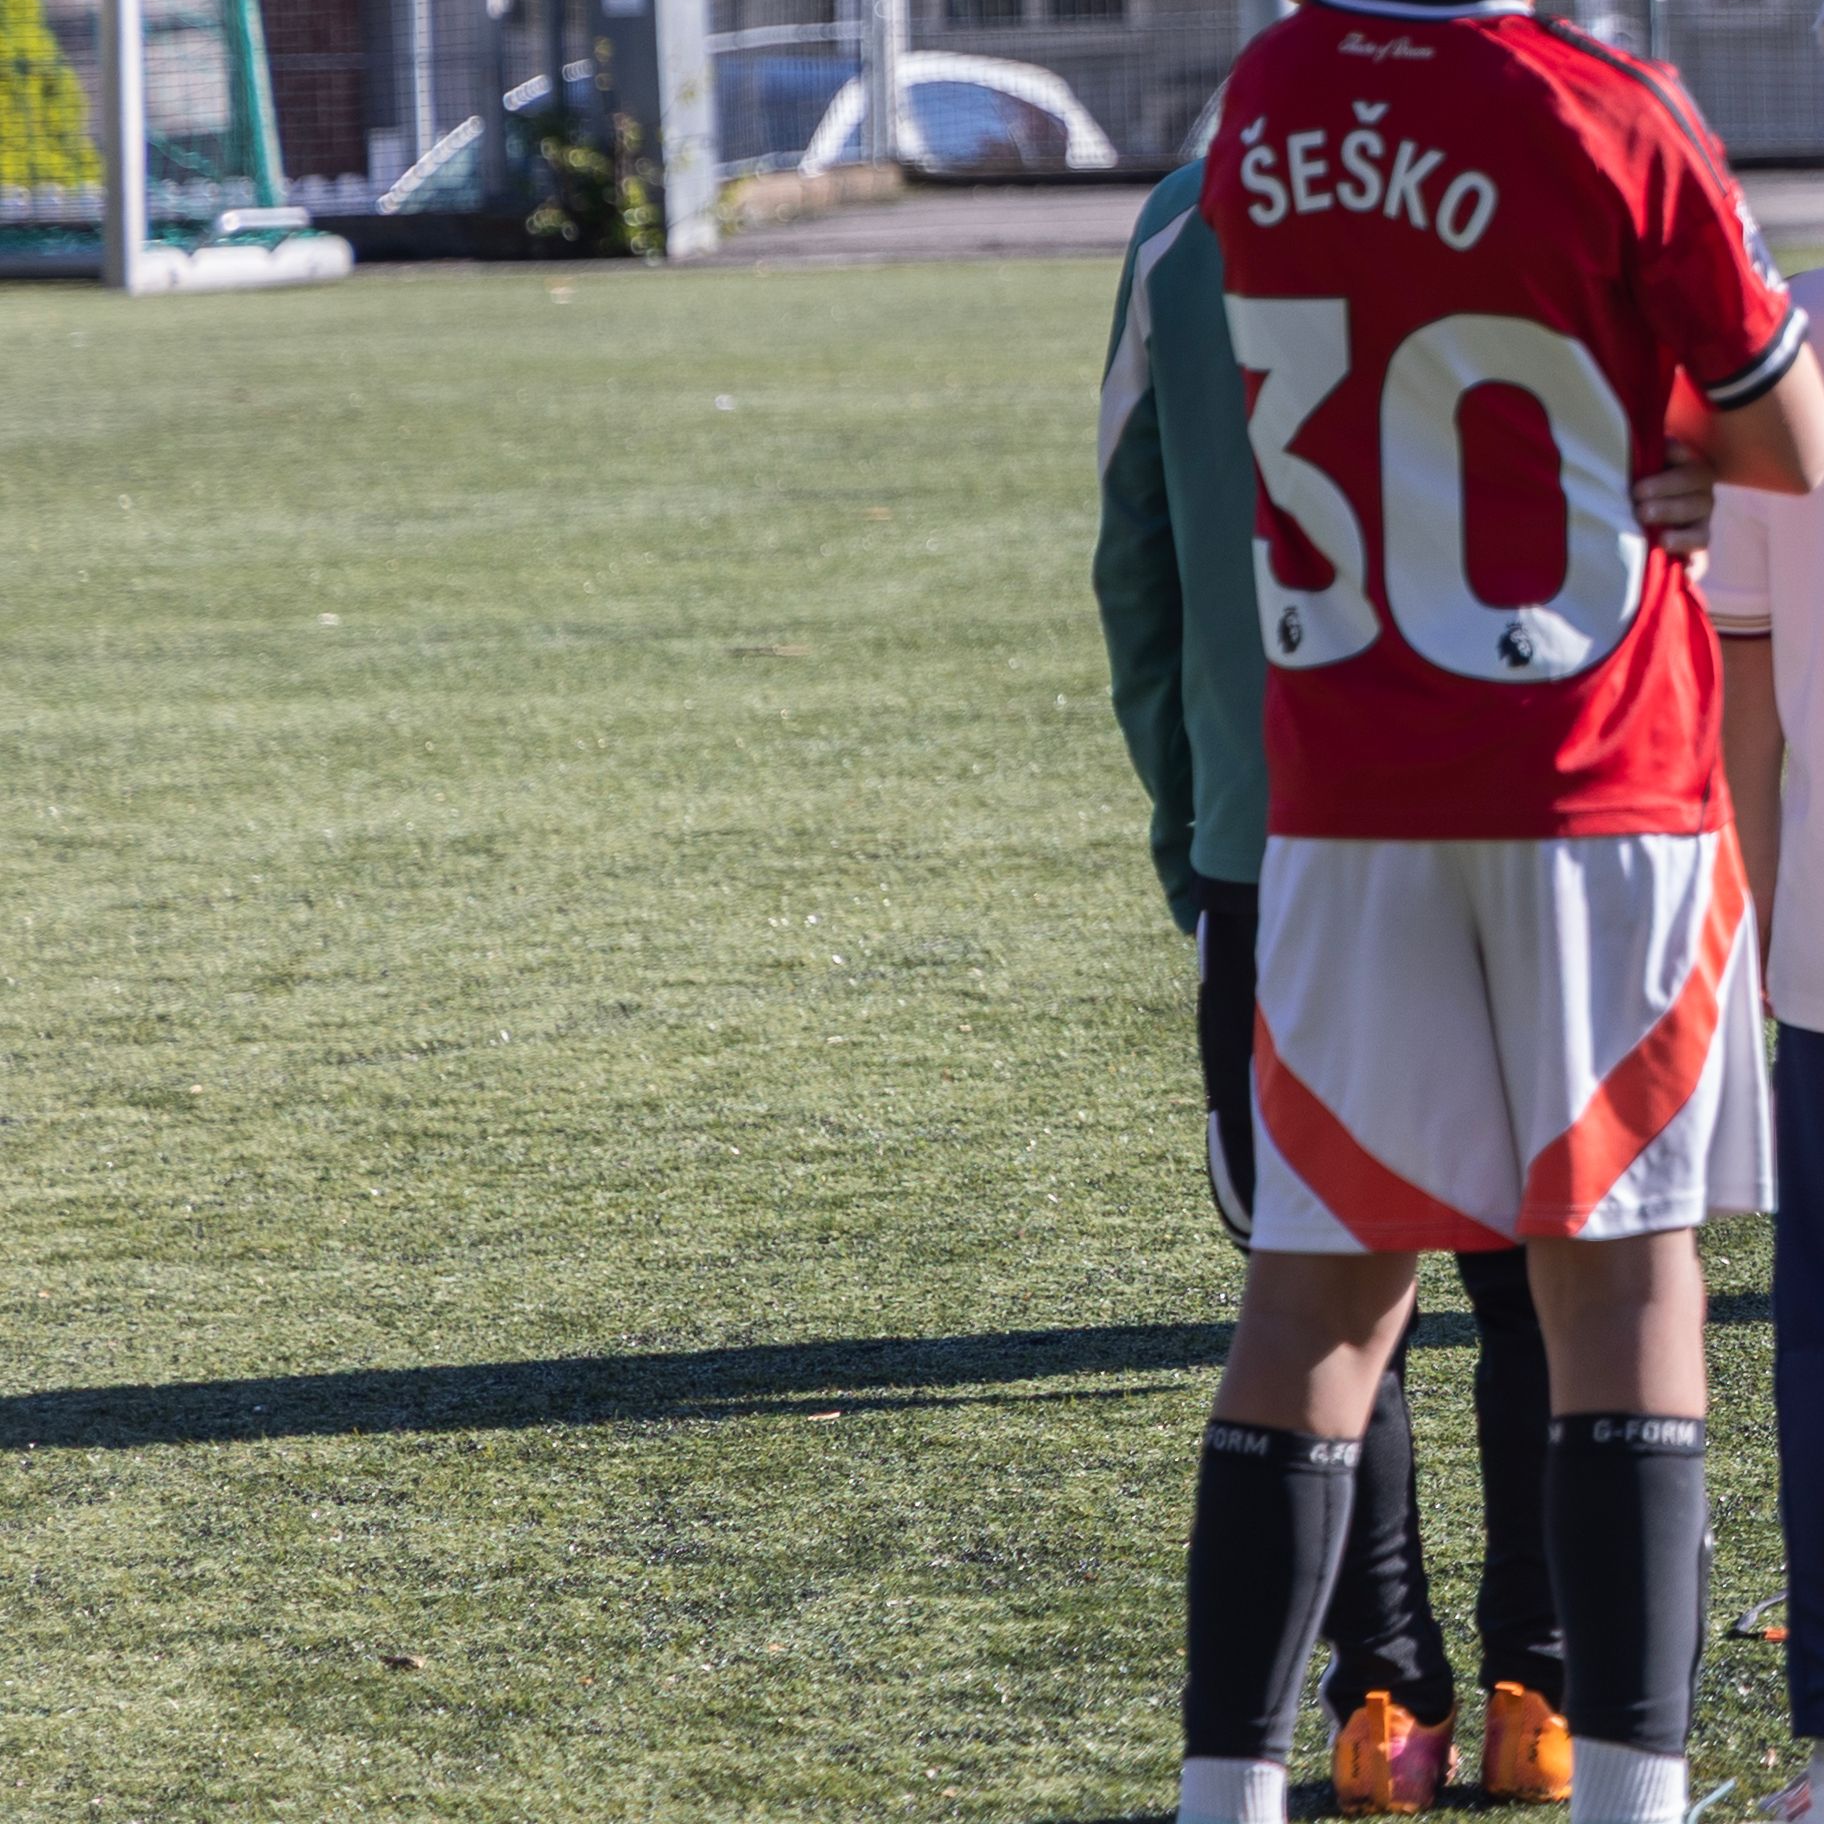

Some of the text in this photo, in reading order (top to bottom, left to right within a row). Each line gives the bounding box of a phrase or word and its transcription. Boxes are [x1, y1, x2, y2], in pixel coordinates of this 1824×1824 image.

[1240, 100, 1498, 252] ŠEŠKO
[1224, 293, 1648, 684] 30
[1593, 1419, 1696, 1448] G-FORM
